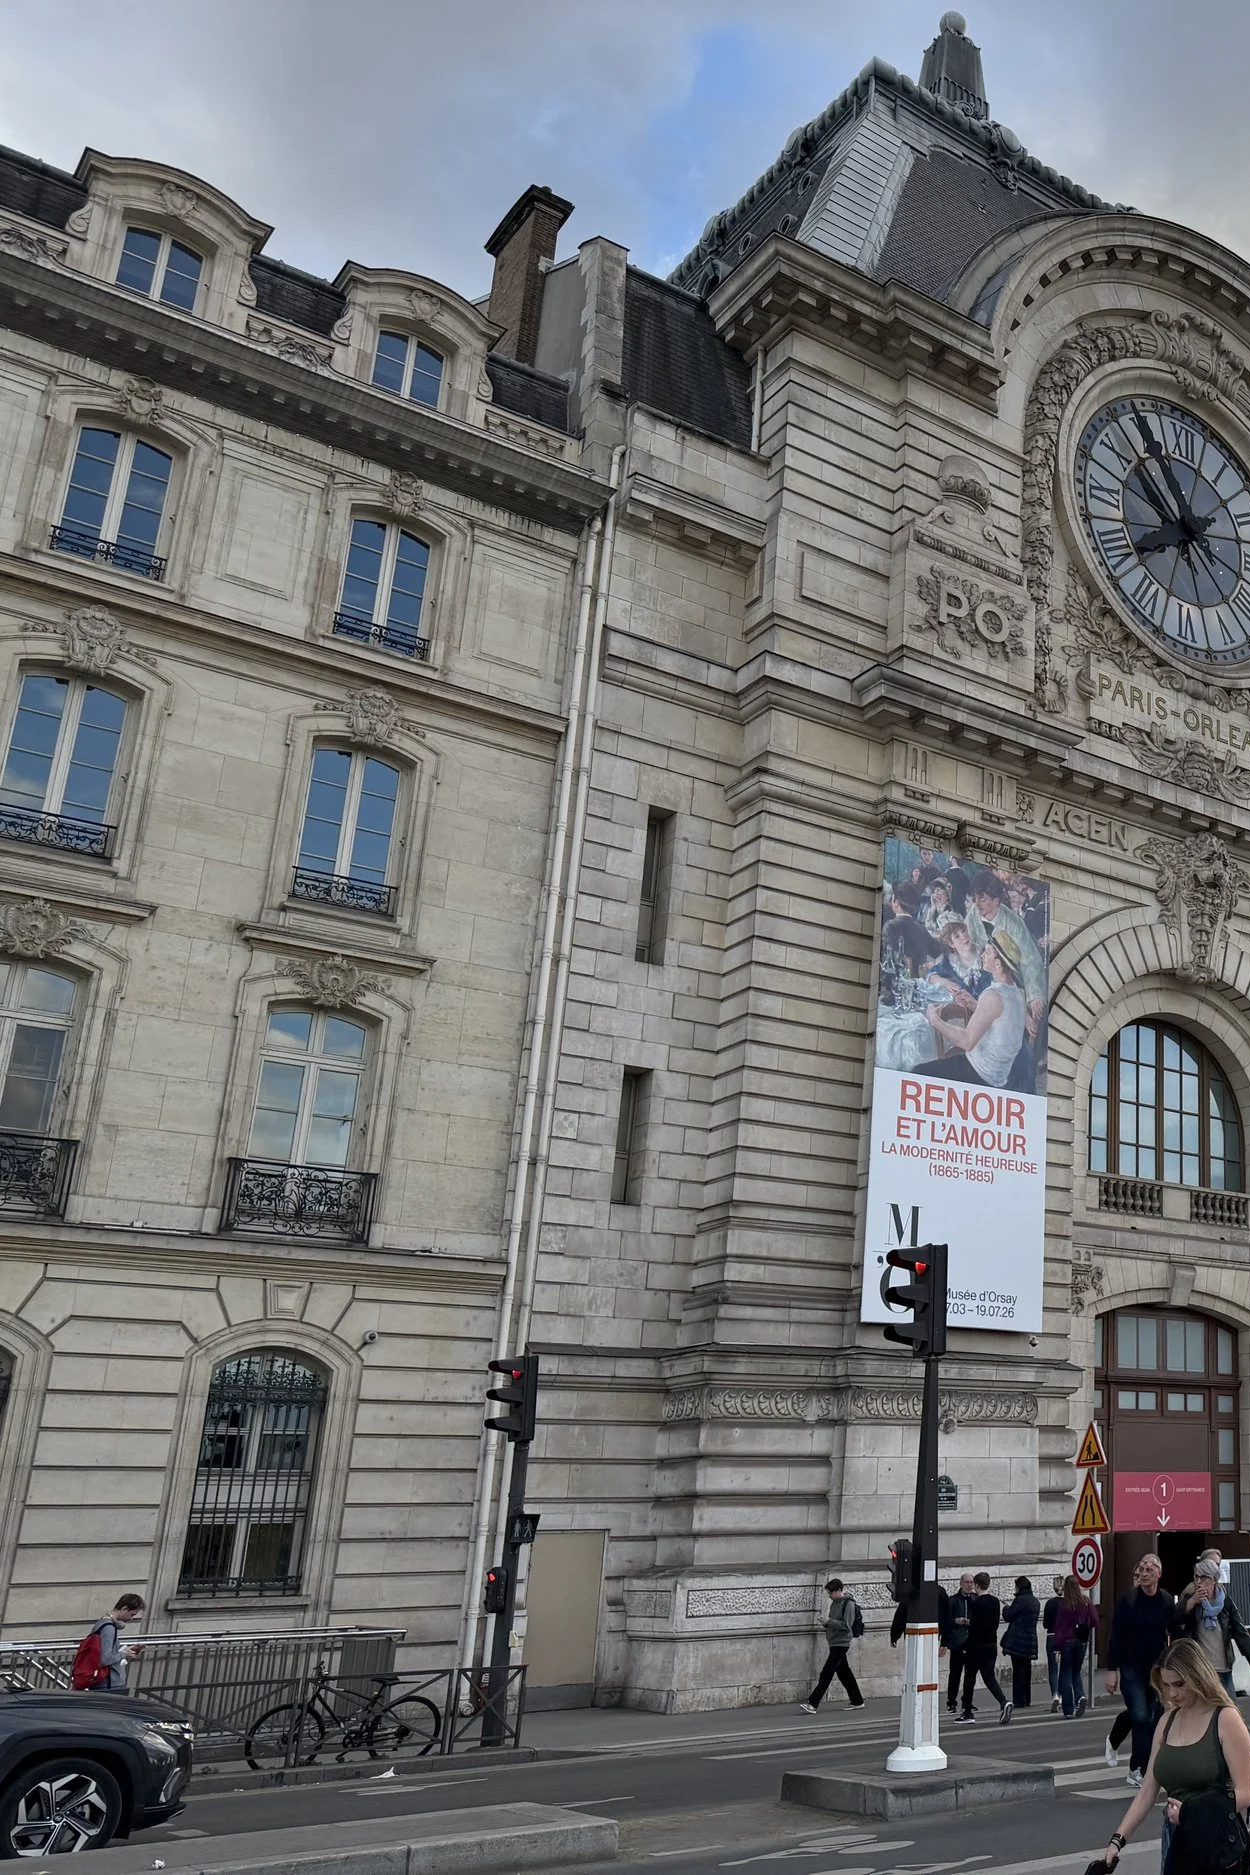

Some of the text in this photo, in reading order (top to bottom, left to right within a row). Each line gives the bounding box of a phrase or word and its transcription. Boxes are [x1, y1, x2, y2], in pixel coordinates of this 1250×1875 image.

[1100, 432, 1133, 472] X
[1170, 422, 1196, 465] XII
[1089, 474, 1121, 512] IX
[1211, 461, 1229, 487] I
[1096, 529, 1134, 572] VIII
[1130, 572, 1158, 620] VII
[1177, 602, 1198, 644] VI
[1215, 609, 1234, 646] V
[900, 1079, 1026, 1130] RENOIR
[896, 1115, 1027, 1156] ET L'AMOUR
[881, 1140, 1038, 1175] LA MODERNITÉ HEUREUSE
[929, 1164, 994, 1185] (1865-1885)
[884, 1203, 923, 1247] M
[976, 1304, 1015, 1318] 19.07.26
[979, 1290, 1018, 1307] d'Orsay
[1160, 1482, 1167, 1497] 1
[1078, 1553, 1096, 1574] 30
